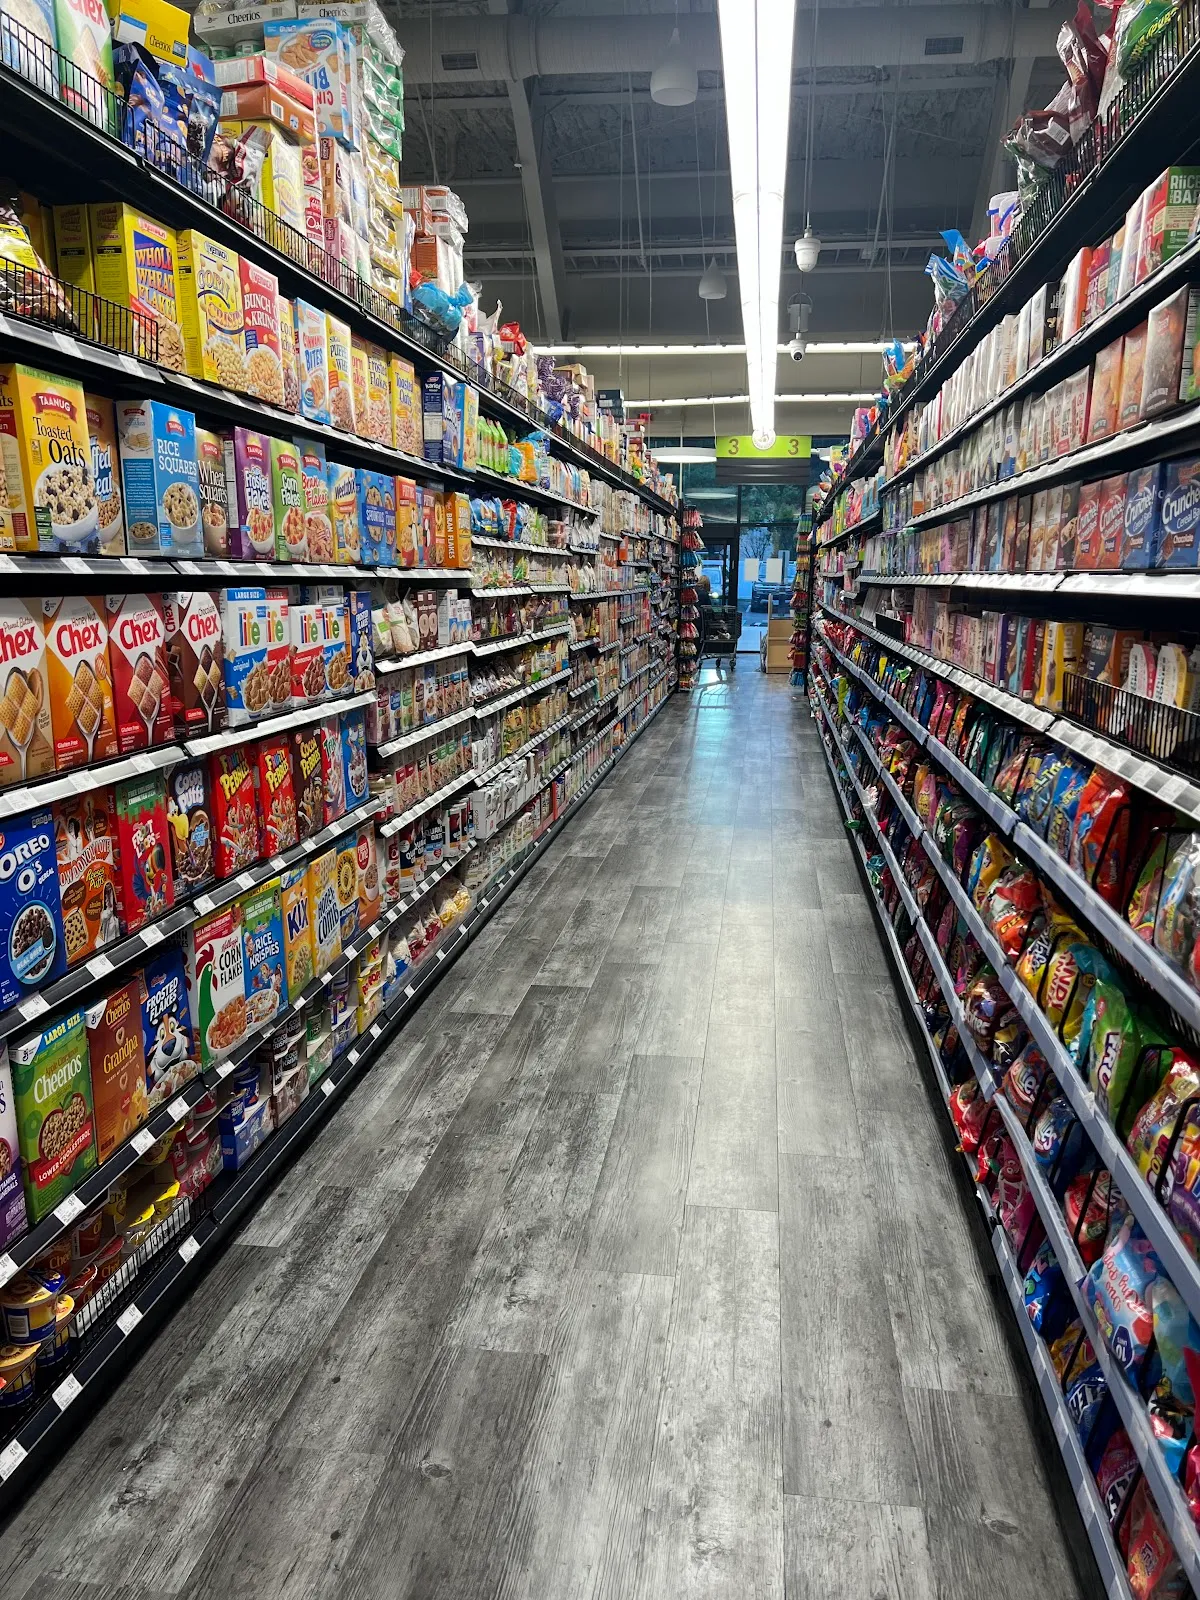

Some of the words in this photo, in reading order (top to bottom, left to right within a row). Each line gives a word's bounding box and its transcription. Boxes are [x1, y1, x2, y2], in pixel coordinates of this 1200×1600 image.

[227, 10, 261, 25] Cheerios
[135, 246, 173, 272] WHOLE
[137, 267, 174, 299] WHEAT
[138, 286, 178, 324] FLAKES
[244, 293, 271, 315] BUNCH
[305, 348, 323, 372] BITES
[38, 395, 71, 412] TAANUG
[87, 411, 100, 423] NUG
[33, 416, 72, 442] Toasted
[48, 438, 86, 468] Oats
[156, 438, 180, 457] RICE
[728, 438, 739, 455] 3
[787, 438, 799, 455] 3
[91, 443, 112, 479] ffed
[158, 455, 197, 476] SQUARES
[198, 460, 226, 488] Wheat
[94, 471, 113, 497] eat
[199, 483, 228, 505] squares
[282, 471, 298, 490] Corn
[281, 486, 301, 507] Flakes
[446, 512, 454, 533] BRAN
[1176, 510, 1193, 529] Cereal
[447, 535, 456, 560] FLAKES
[1173, 535, 1194, 544] Chocolate
[234, 591, 250, 600] LARGE
[250, 591, 261, 599] SIZE
[165, 603, 176, 633] Chex
[187, 613, 220, 642] Chex
[239, 610, 261, 647] life
[266, 605, 284, 642] ife
[300, 613, 318, 644] life
[322, 610, 340, 640] life
[56, 622, 103, 658] Chex
[119, 617, 162, 650] Chex
[175, 768, 202, 795] Cocoa
[220, 760, 249, 801] PEBBLES
[265, 762, 289, 795] PEBBLES
[0, 834, 50, 880] OREO
[38, 869, 55, 885] CEREAL
[255, 931, 273, 951] RICE
[219, 943, 242, 970] CORN
[249, 941, 280, 970] KRISPIES
[220, 964, 243, 988] FLAKES
[146, 976, 179, 1013] FROSTED
[150, 990, 178, 1022] FLAKES
[105, 998, 131, 1026] Cheerios
[43, 1022, 66, 1046] LARGE
[66, 1012, 80, 1030] SIZE
[103, 1033, 139, 1074] Grandpa
[33, 1054, 82, 1104] Cheerios
[38, 1158, 60, 1182] LOWER
[59, 1128, 91, 1170] CHOLESTEROL
